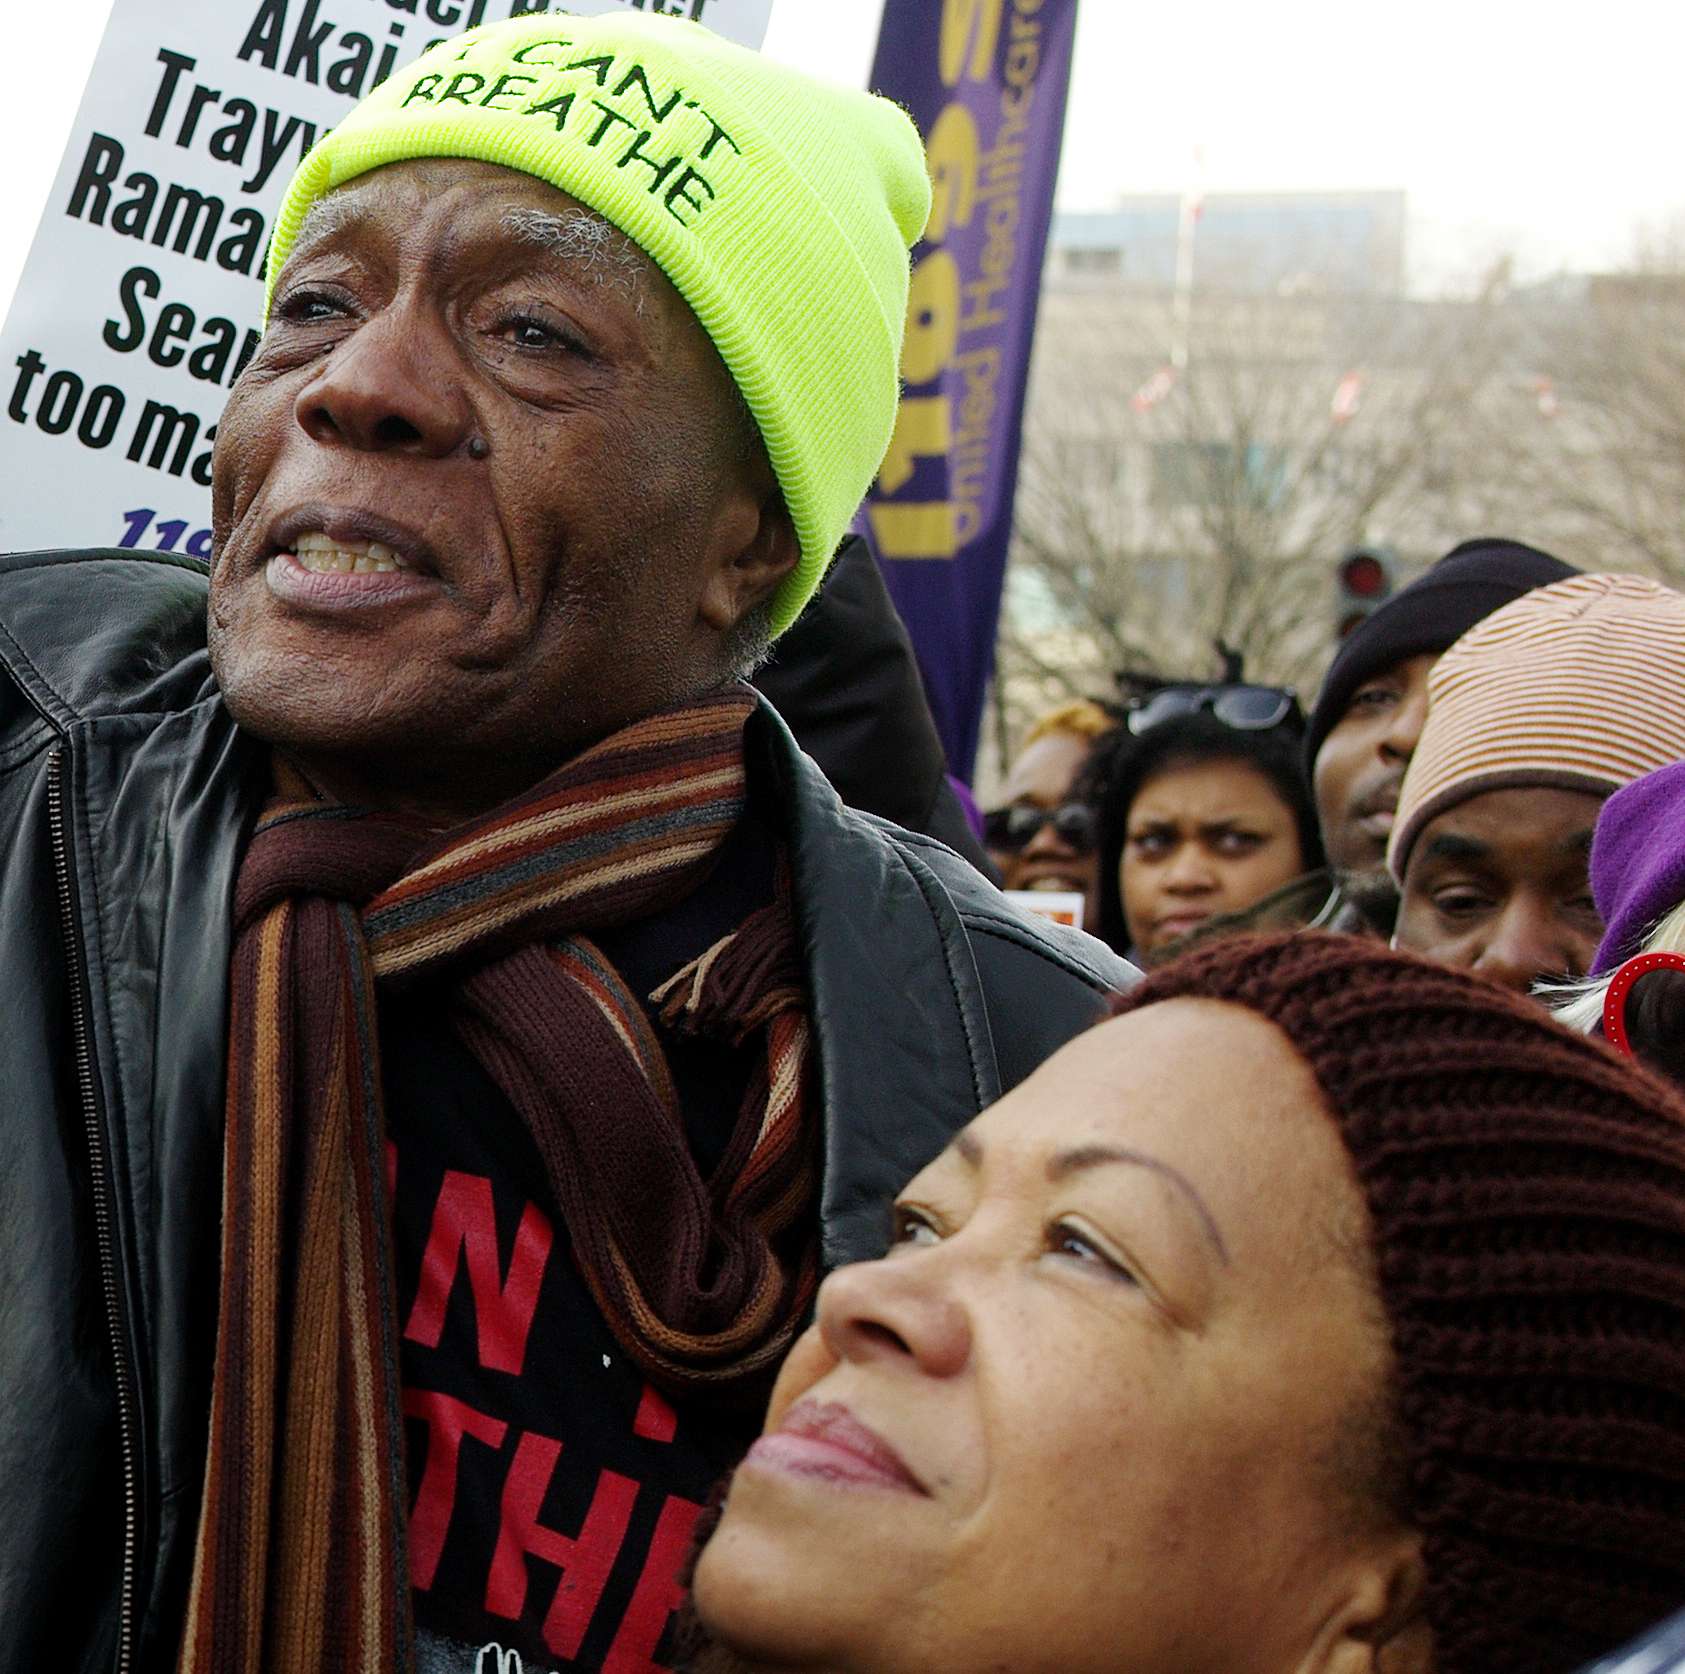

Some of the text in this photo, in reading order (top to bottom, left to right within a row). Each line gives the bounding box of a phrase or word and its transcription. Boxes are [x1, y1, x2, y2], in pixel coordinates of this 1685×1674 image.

[237, 0, 406, 103] Akai
[512, 39, 741, 159] CAN'T
[400, 73, 714, 227] BREATHE
[8, 349, 125, 449] too
